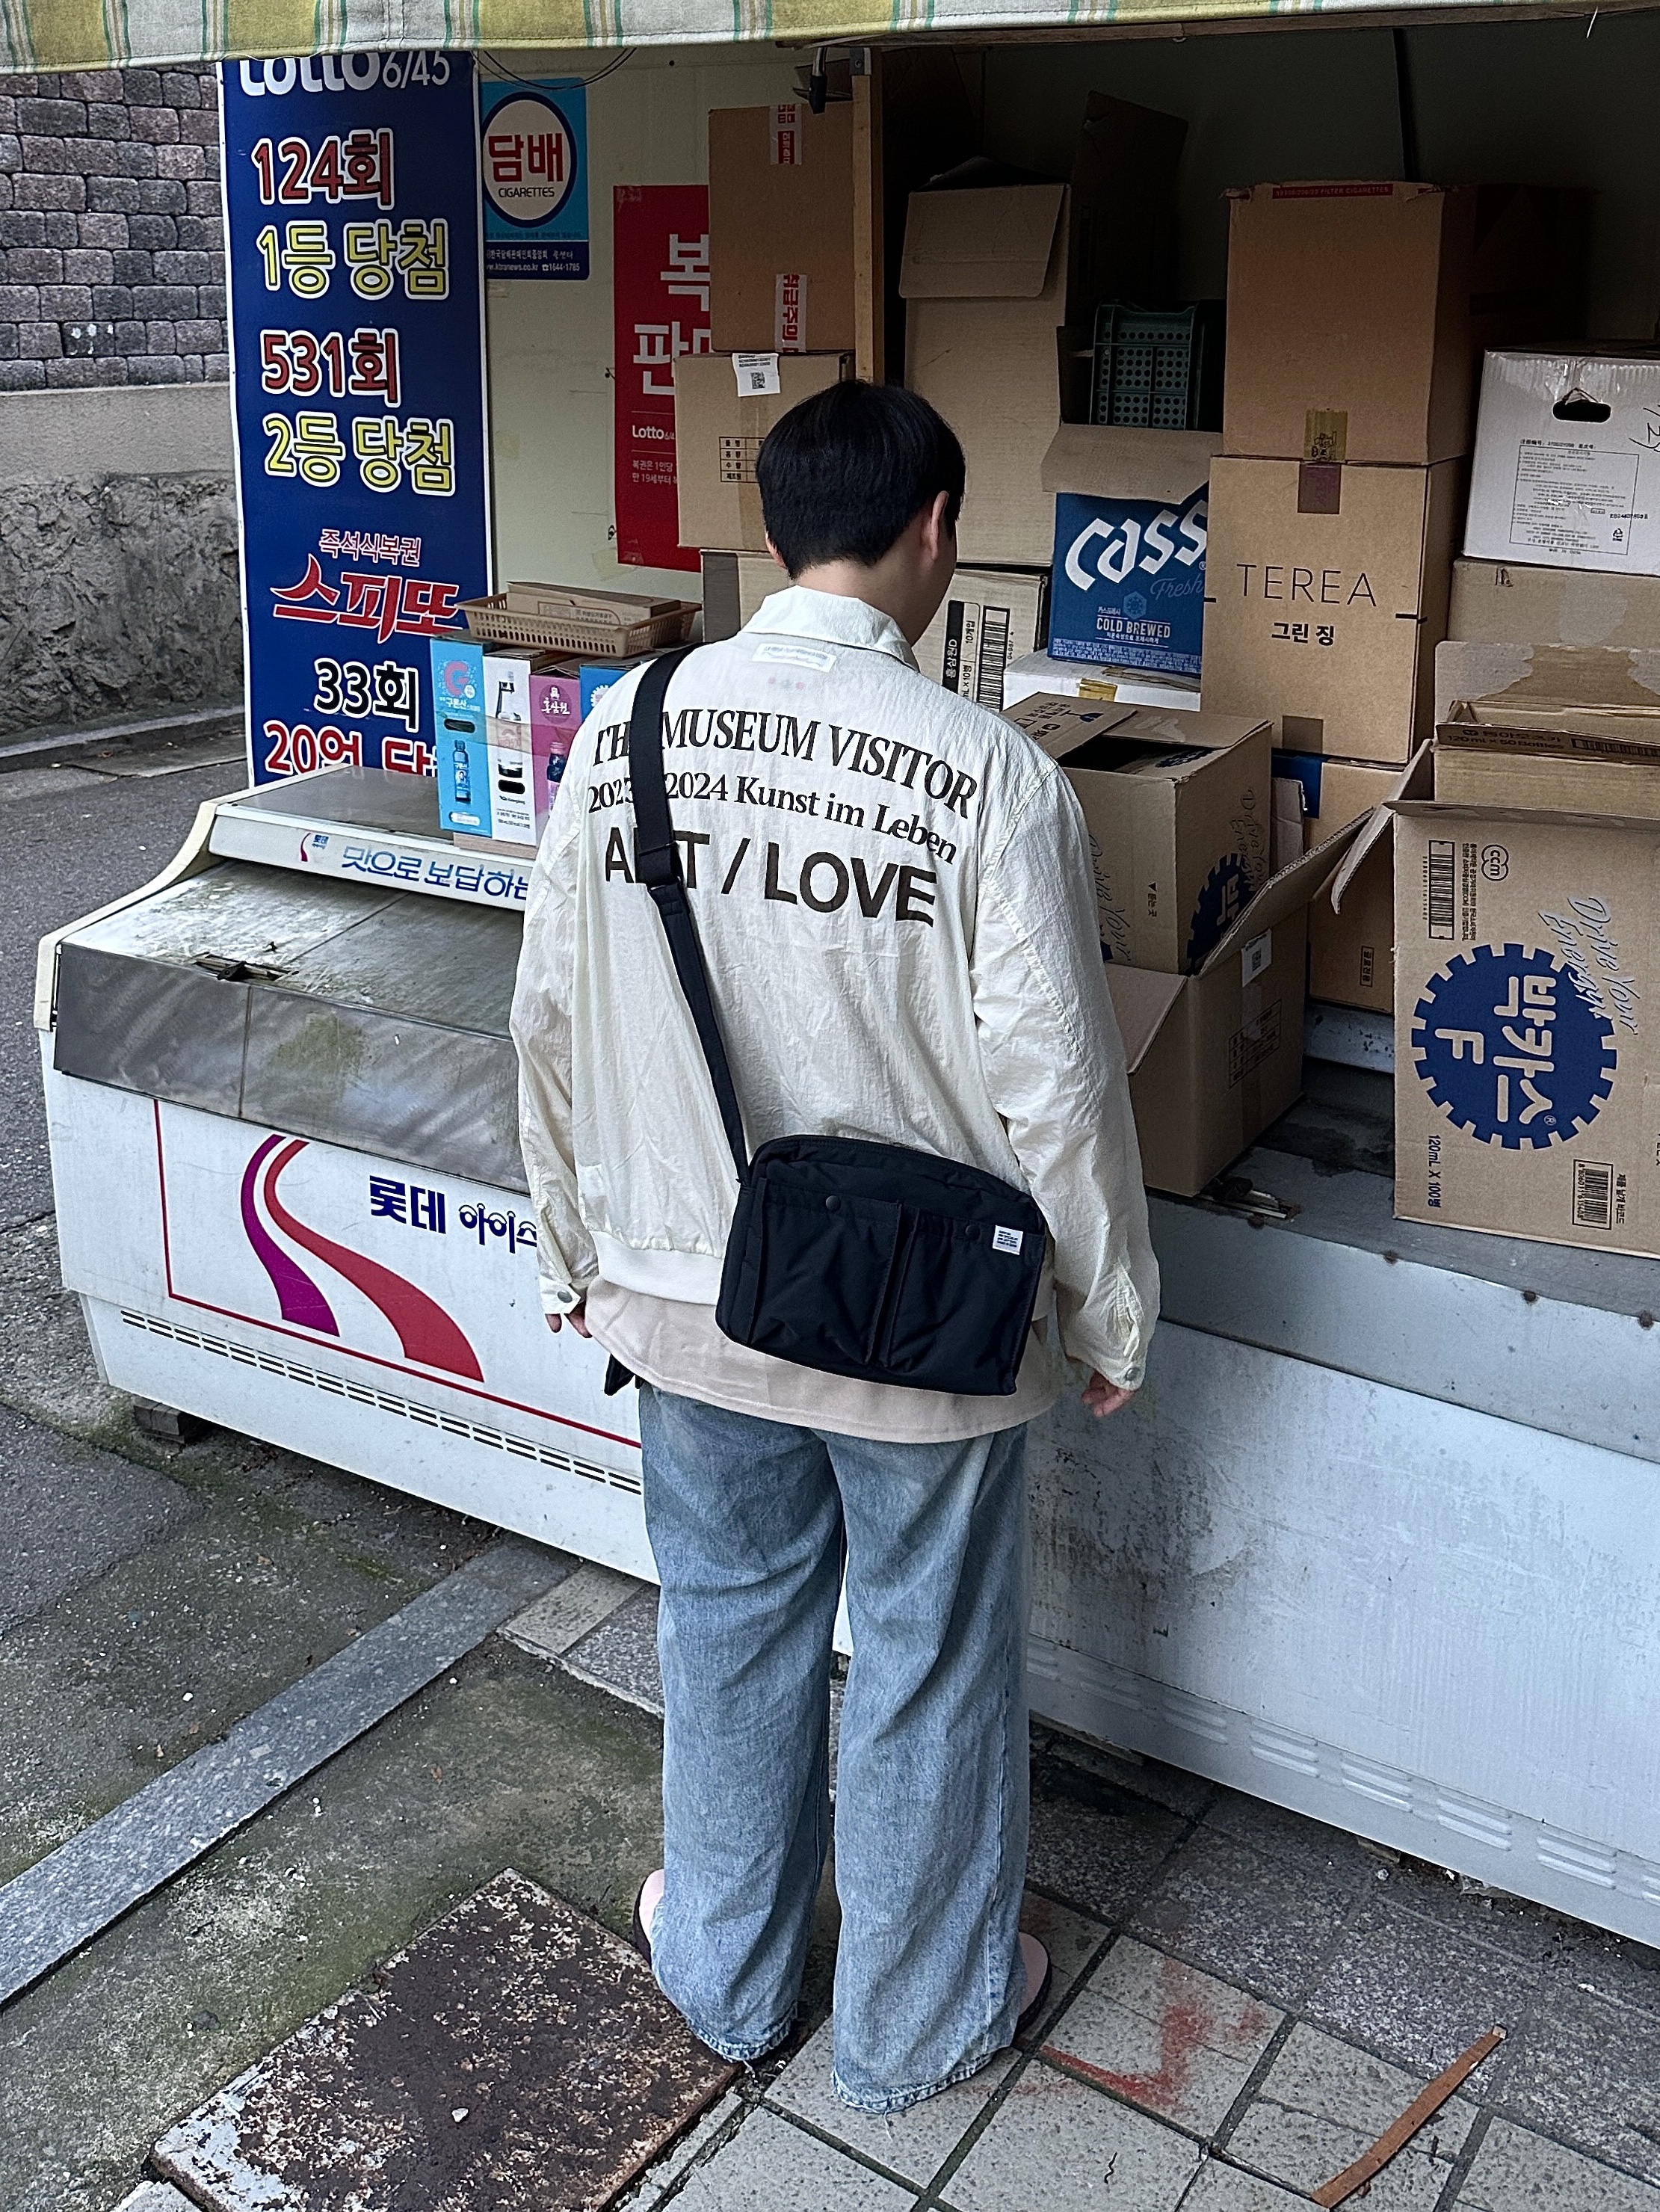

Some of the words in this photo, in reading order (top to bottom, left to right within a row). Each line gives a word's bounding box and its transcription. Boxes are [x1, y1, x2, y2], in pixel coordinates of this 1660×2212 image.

[251, 127, 395, 211] 124회
[488, 132, 564, 182] 담배
[498, 187, 555, 198] CIGARETTES
[256, 220, 336, 299] 1등
[343, 218, 449, 300] 당첨
[661, 234, 710, 312] 복
[783, 274, 800, 342] 취급주의
[260, 327, 401, 407] 531회
[262, 411, 346, 487] 2등
[352, 414, 455, 496] 당첨
[632, 425, 664, 440] Lotto
[319, 528, 422, 567] 즉석식복권
[270, 553, 464, 643] 스피또
[1237, 564, 1376, 606] TEREA
[966, 620, 975, 644] 10개입
[1096, 617, 1123, 633] COLD
[1126, 620, 1171, 638] BREWED
[1271, 622, 1309, 643] 그린
[1315, 624, 1335, 646] 징
[945, 639, 957, 678] 홍삼원D
[314, 658, 419, 733] 33회
[383, 736, 437, 777] 당
[593, 720, 631, 766] TH
[662, 709, 821, 761] MUSEUM
[828, 724, 977, 819] VISITOR
[664, 772, 728, 801] 2024
[734, 775, 820, 816] Kunst
[824, 792, 864, 828] im
[871, 803, 957, 864] Leben
[342, 845, 422, 882] 맛으로
[605, 827, 710, 889] AT
[764, 842, 937, 927] LOVE
[1490, 849, 1501, 876] ccm
[1217, 873, 1240, 927] 박
[1567, 896, 1620, 972] Drive
[1601, 975, 1641, 1036] Your
[1434, 1028, 1484, 1065] F
[1493, 974, 1557, 1124] 박카스
[1428, 1133, 1442, 1168] 120mL
[369, 1175, 446, 1234] 롯데
[458, 1203, 537, 1254] 아이스
[1427, 1181, 1442, 1208] 100병
